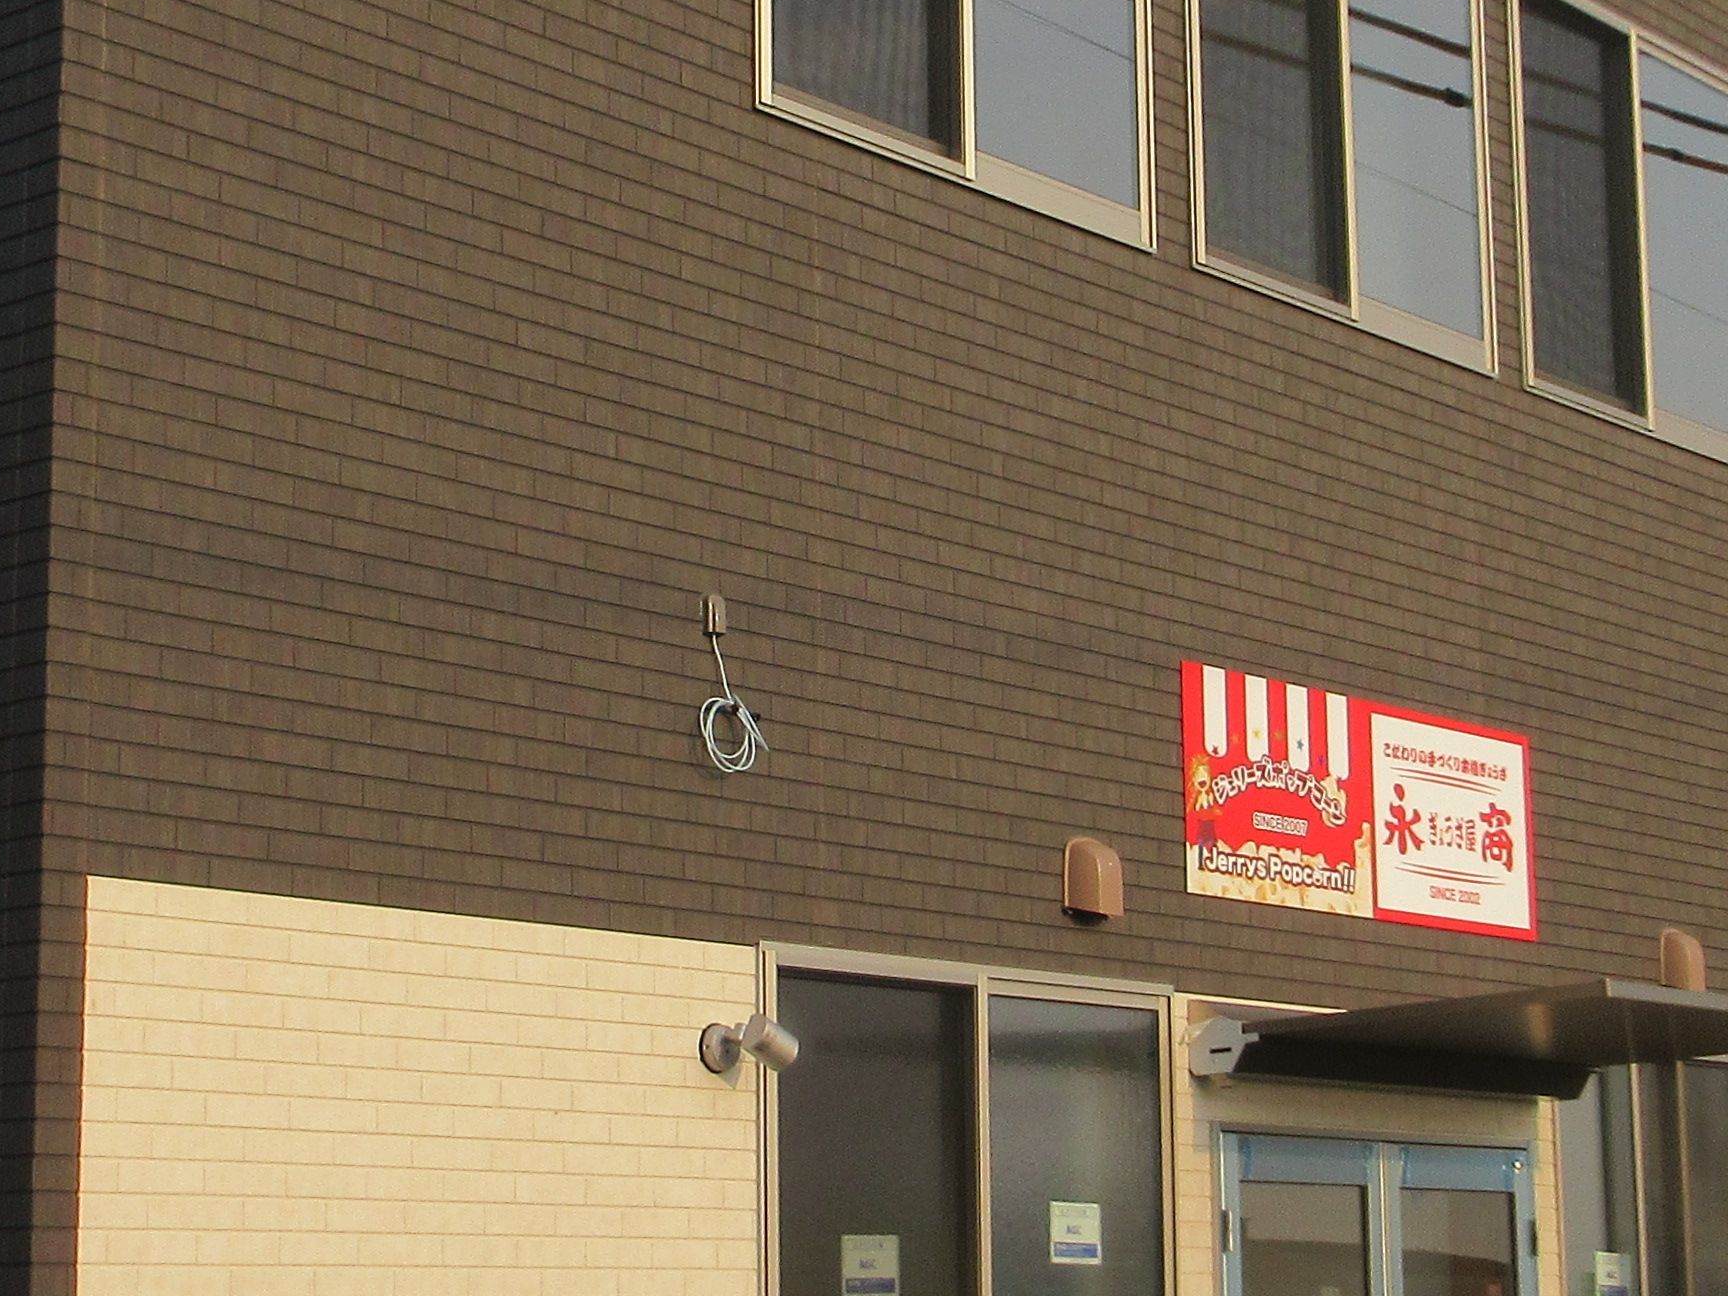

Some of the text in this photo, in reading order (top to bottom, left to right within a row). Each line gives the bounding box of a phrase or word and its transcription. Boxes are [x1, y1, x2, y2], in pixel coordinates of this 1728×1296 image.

[1253, 812, 1308, 836] SINCE 2007
[1205, 846, 1267, 878] Jerrys
[1429, 885, 1456, 902] SINCE
